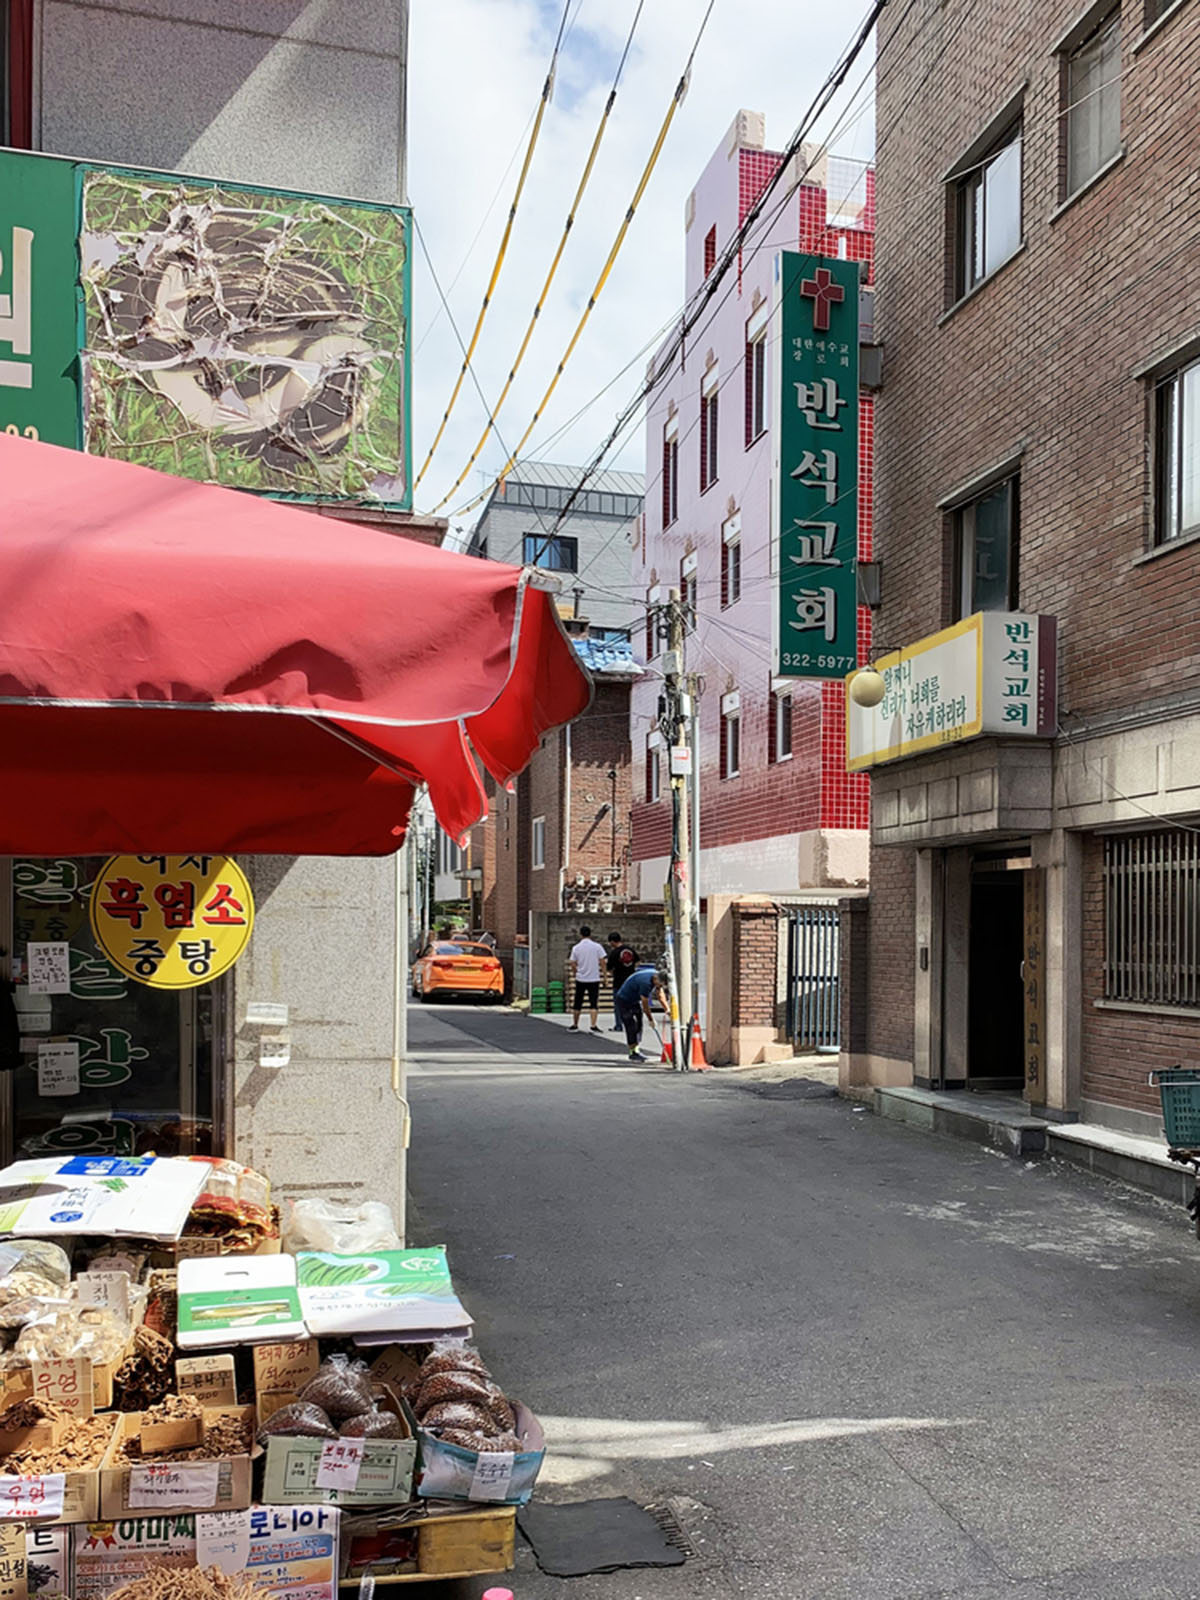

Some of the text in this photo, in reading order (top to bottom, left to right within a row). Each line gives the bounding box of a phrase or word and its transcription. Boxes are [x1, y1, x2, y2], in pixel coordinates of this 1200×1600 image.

[789, 377, 846, 642] 반석교회
[782, 653, 855, 669] 322-5977
[1001, 621, 1034, 727] 반석교회
[101, 878, 247, 929] 흑염소
[126, 939, 217, 975] 중탕
[36, 1369, 78, 1401] 우엉
[4, 1480, 46, 1505] 우엉
